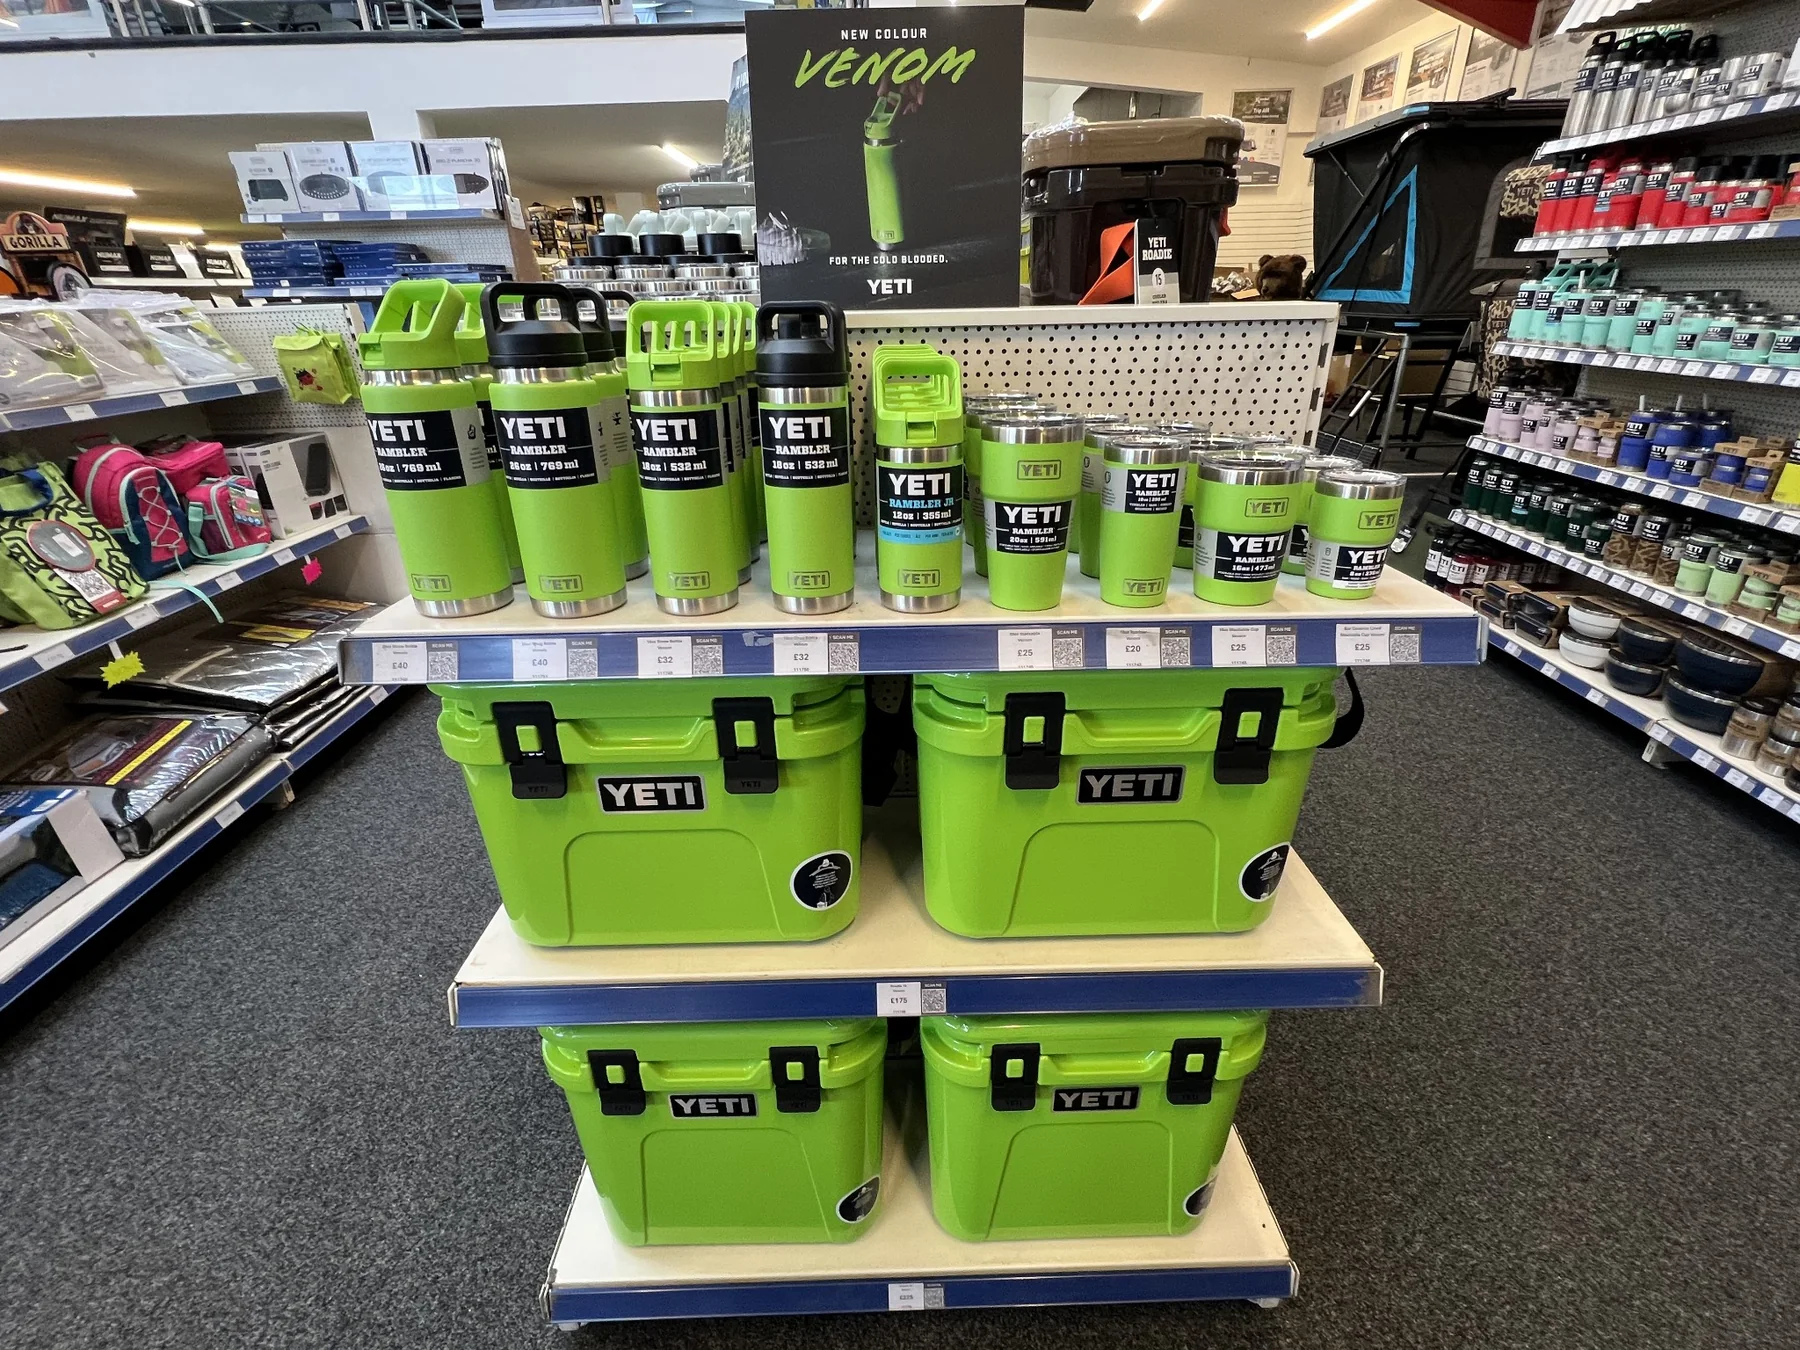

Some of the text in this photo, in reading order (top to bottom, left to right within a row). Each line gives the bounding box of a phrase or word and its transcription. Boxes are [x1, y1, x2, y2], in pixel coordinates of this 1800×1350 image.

[841, 28, 927, 40] NEW COLOUR
[794, 46, 976, 88] VENOM
[1517, 186, 1533, 196] YETI
[9, 234, 63, 249] GORILLA
[1148, 237, 1167, 248] YETI
[97, 251, 122, 259] NUMAX
[829, 254, 949, 265] FOR THE COLD BLOODED.
[1142, 249, 1173, 261] ROADIE
[1155, 273, 1162, 286] 15
[867, 279, 913, 294] YETI
[368, 419, 426, 441] YETI
[500, 416, 566, 439] YETI
[636, 419, 697, 441] YETI
[768, 416, 831, 439] YETI
[510, 445, 567, 455] RAMBLER
[642, 447, 697, 457] RAMBLER
[775, 444, 831, 455] RAMBLER
[1021, 465, 1058, 477] YETI
[889, 473, 951, 496] YETI
[1131, 473, 1176, 488] YETI
[889, 497, 954, 508] RAMBLER JR
[1249, 500, 1285, 514] YETI
[1003, 505, 1062, 524] YETI
[1364, 514, 1395, 526] YETI
[1012, 527, 1054, 535] RAMBLER
[1228, 535, 1284, 553] YETI
[1348, 549, 1388, 564] YETI
[673, 574, 706, 586] YETI
[792, 573, 826, 586] YETI
[902, 572, 936, 584] YETI
[1753, 571, 1769, 580] YETI
[414, 576, 448, 590] YETI
[542, 577, 579, 590] YETI
[1126, 581, 1161, 593] YETI
[1017, 649, 1033, 657] £25
[1126, 645, 1141, 653] £20
[1231, 644, 1247, 652] £25
[1355, 643, 1370, 651] £25
[532, 659, 548, 667] £40
[658, 656, 673, 664] £32
[794, 653, 809, 661] £32
[392, 662, 408, 670] £40
[740, 780, 761, 788] YETI
[1085, 773, 1174, 798] YETI
[603, 782, 697, 807] YETI
[1058, 1091, 1132, 1108] YETI
[675, 1098, 750, 1114] YETI
